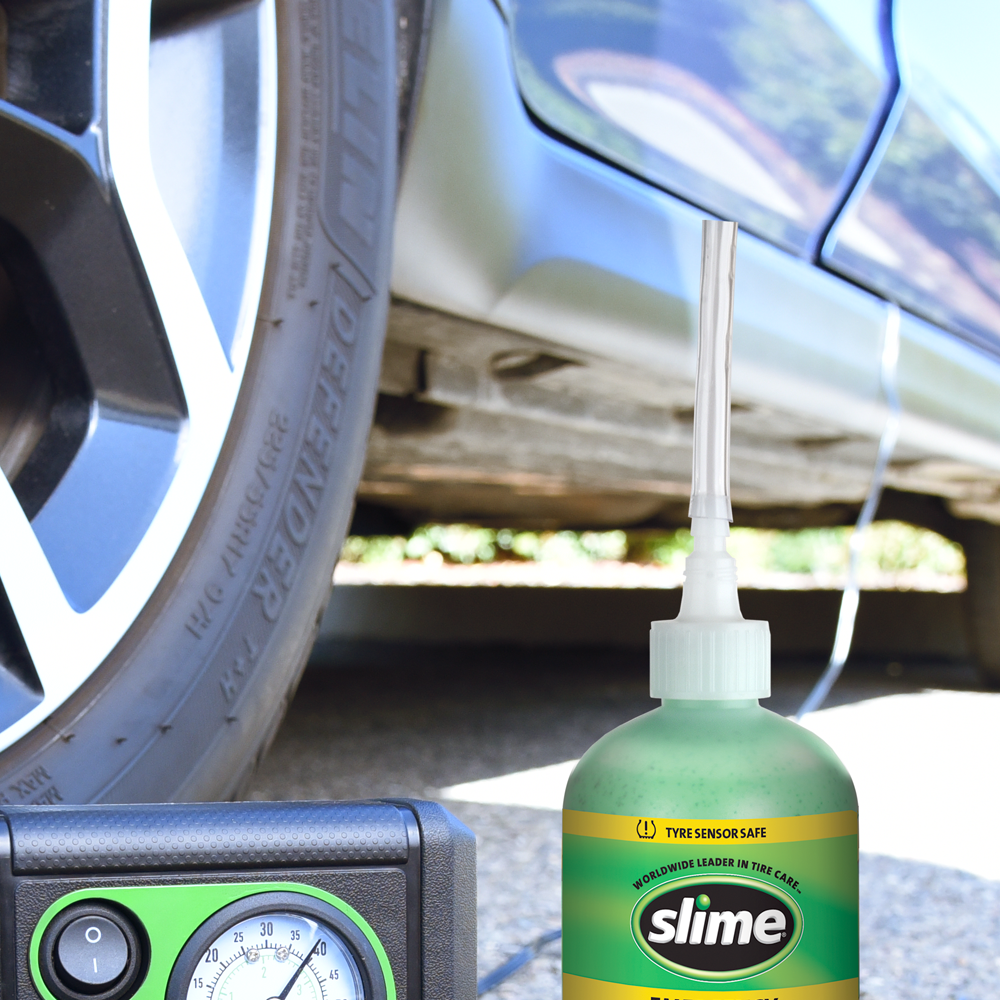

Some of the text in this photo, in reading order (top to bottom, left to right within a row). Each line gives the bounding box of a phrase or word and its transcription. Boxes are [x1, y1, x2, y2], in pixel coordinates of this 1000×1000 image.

[257, 298, 357, 625] DEFENDER
[666, 827, 767, 839] TYRE SENSOR SAFE
[632, 859, 695, 890] WORLDWIDE
[697, 858, 735, 868] LEADER
[737, 859, 749, 869] IN
[751, 861, 773, 876] TIRE
[260, 922, 274, 937] 30
[290, 930, 301, 941] 35
[233, 931, 244, 943] 25
[314, 941, 327, 956] 40
[205, 948, 219, 963] 20
[329, 970, 339, 981] 45
[193, 978, 204, 989] 15
